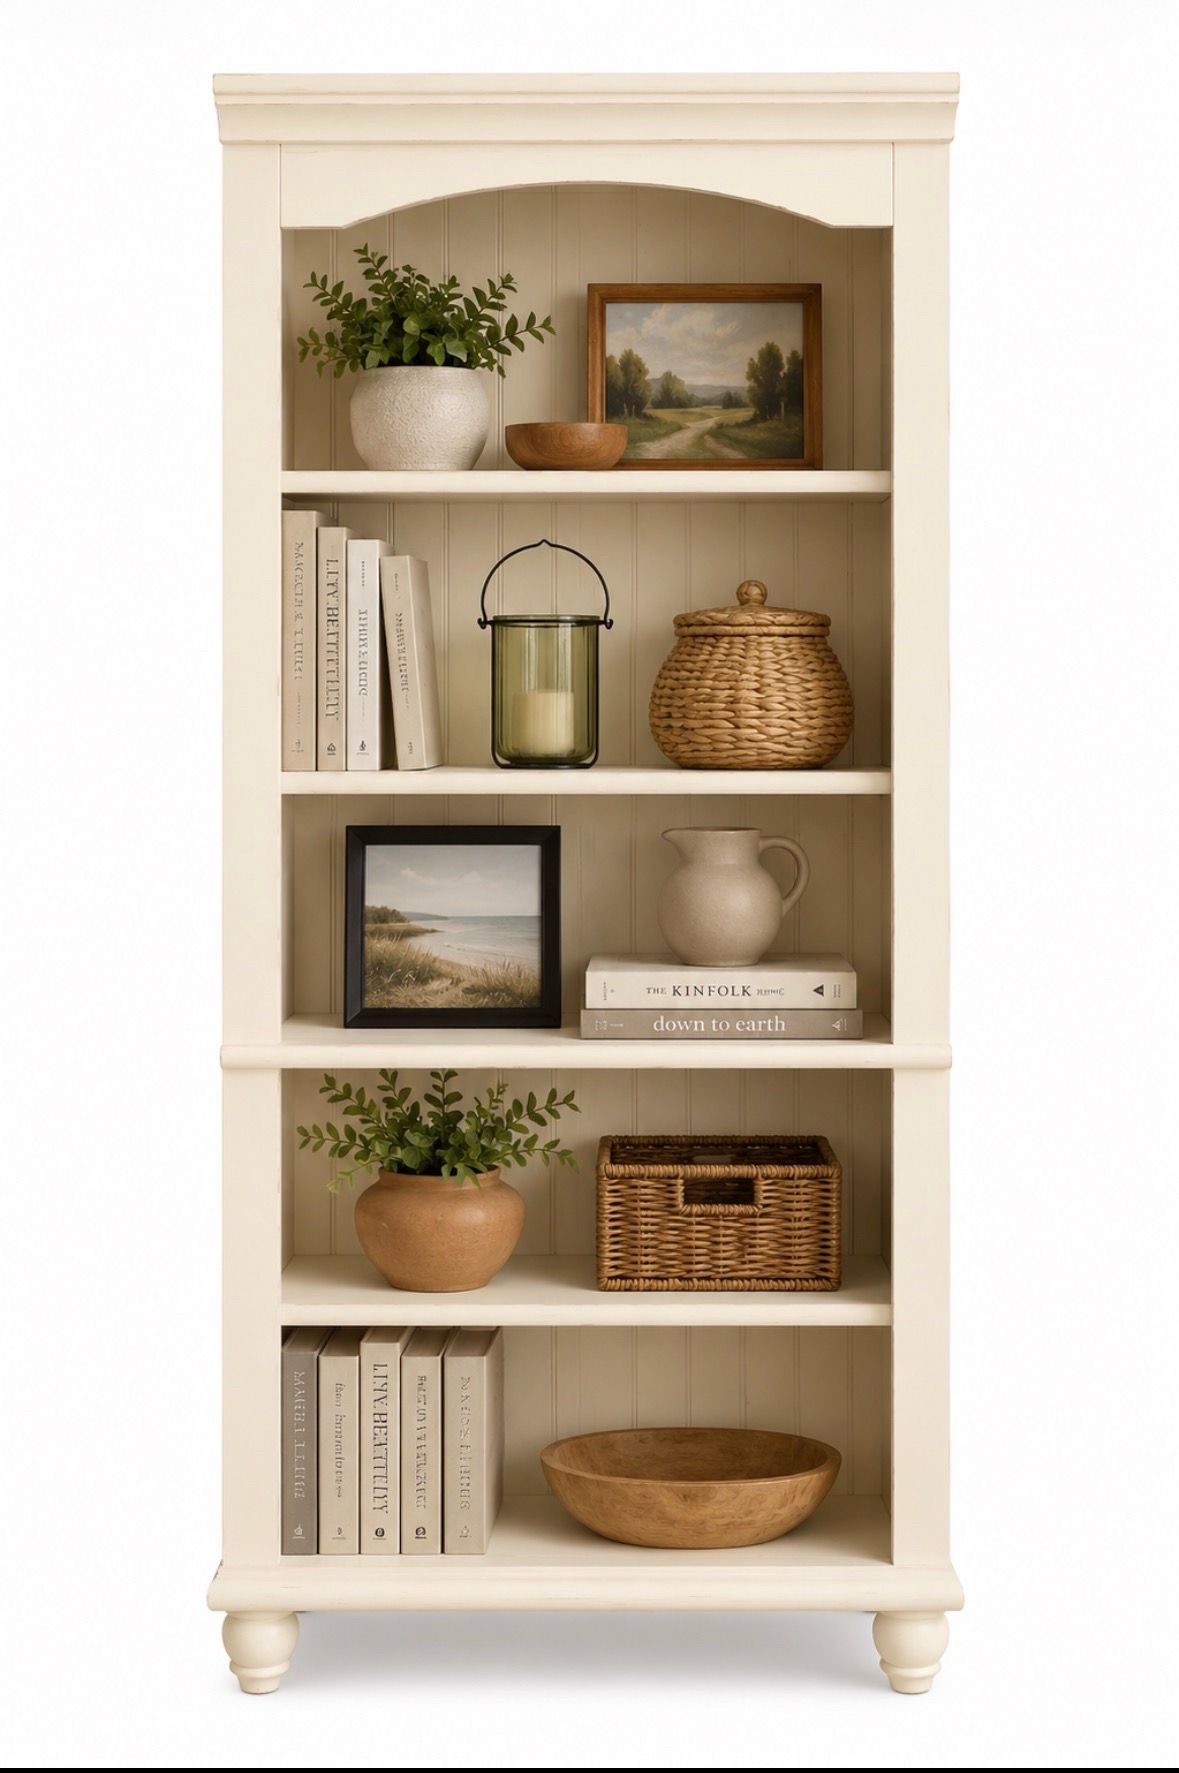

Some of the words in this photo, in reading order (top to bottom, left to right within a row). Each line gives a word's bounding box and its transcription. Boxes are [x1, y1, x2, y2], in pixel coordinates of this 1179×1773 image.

[646, 986, 667, 995] THE
[672, 984, 752, 997] KINFOLK
[653, 1015, 705, 1032] down
[711, 1018, 731, 1032] to
[735, 1015, 786, 1032] earth
